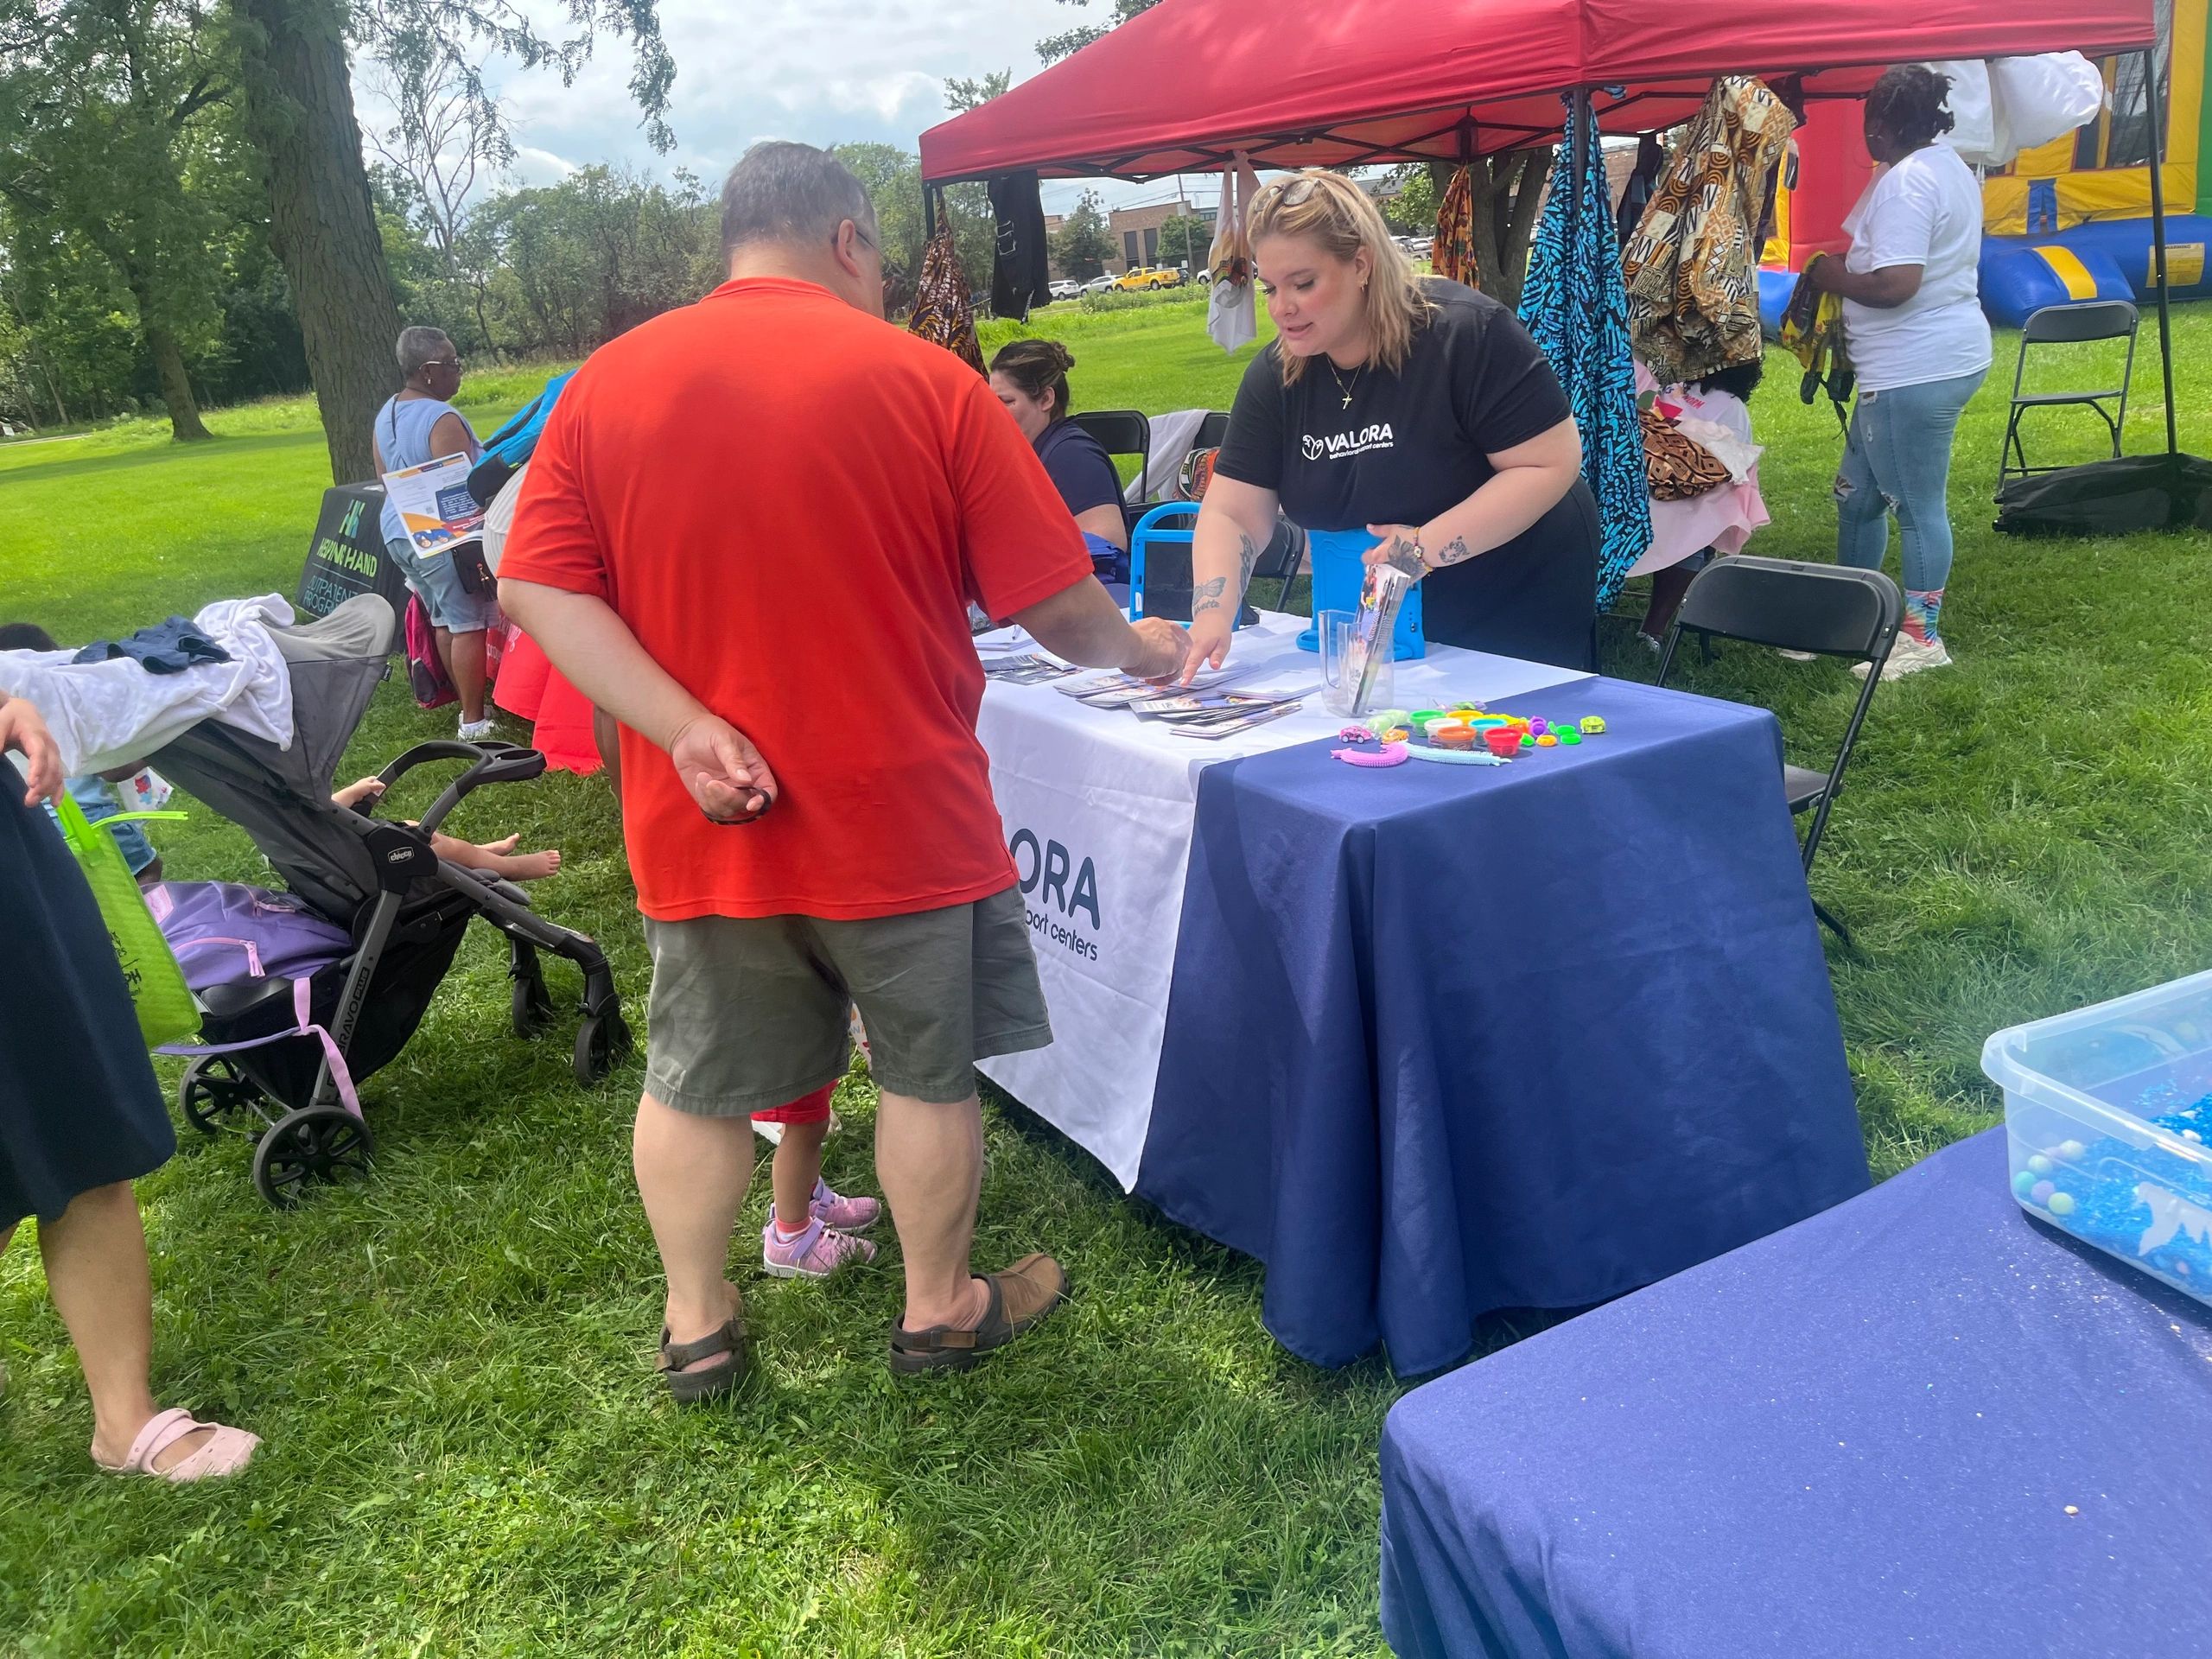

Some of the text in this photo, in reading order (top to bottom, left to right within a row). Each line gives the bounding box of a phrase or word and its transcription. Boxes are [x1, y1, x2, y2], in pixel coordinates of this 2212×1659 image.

[1325, 423, 1393, 453] VALORA
[343, 547, 378, 577] HAND
[1009, 828, 1101, 931] ORA
[1025, 909, 1098, 962] port centers
